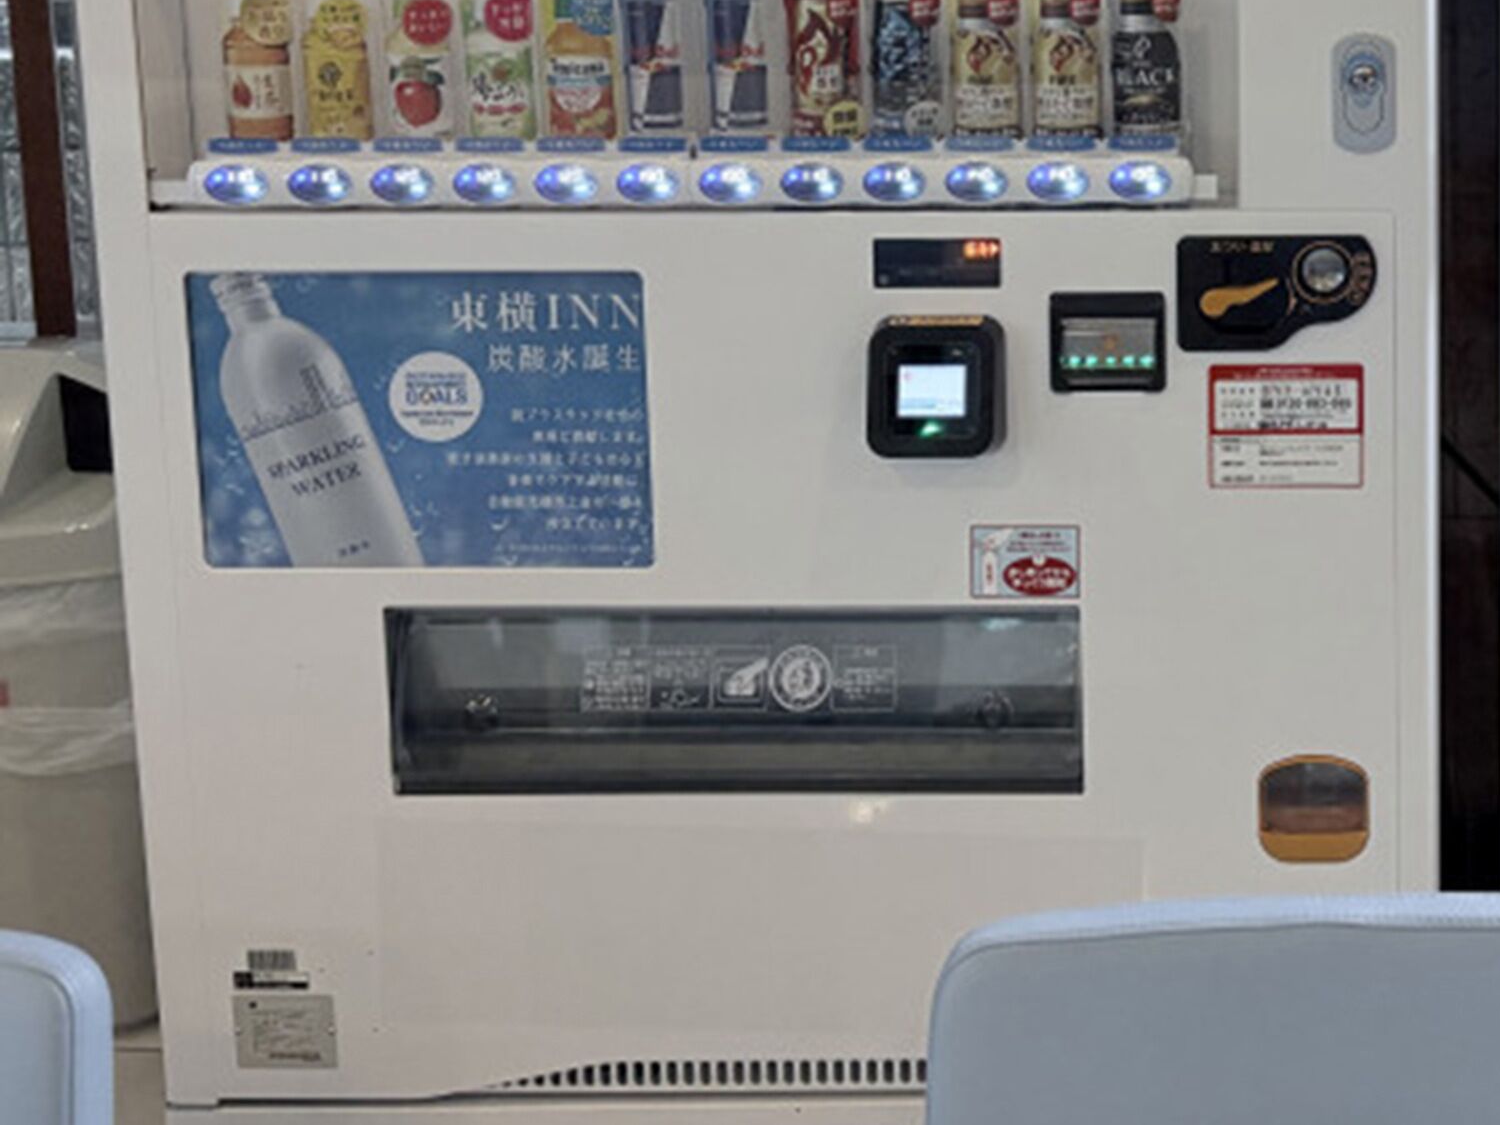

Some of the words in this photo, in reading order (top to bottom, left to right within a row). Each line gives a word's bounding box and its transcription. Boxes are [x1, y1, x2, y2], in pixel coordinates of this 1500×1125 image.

[451, 291, 639, 333] 東横INN
[488, 345, 641, 373] 炭酸水誕生
[268, 435, 366, 479] SPARKLING
[291, 463, 363, 499] WATER
